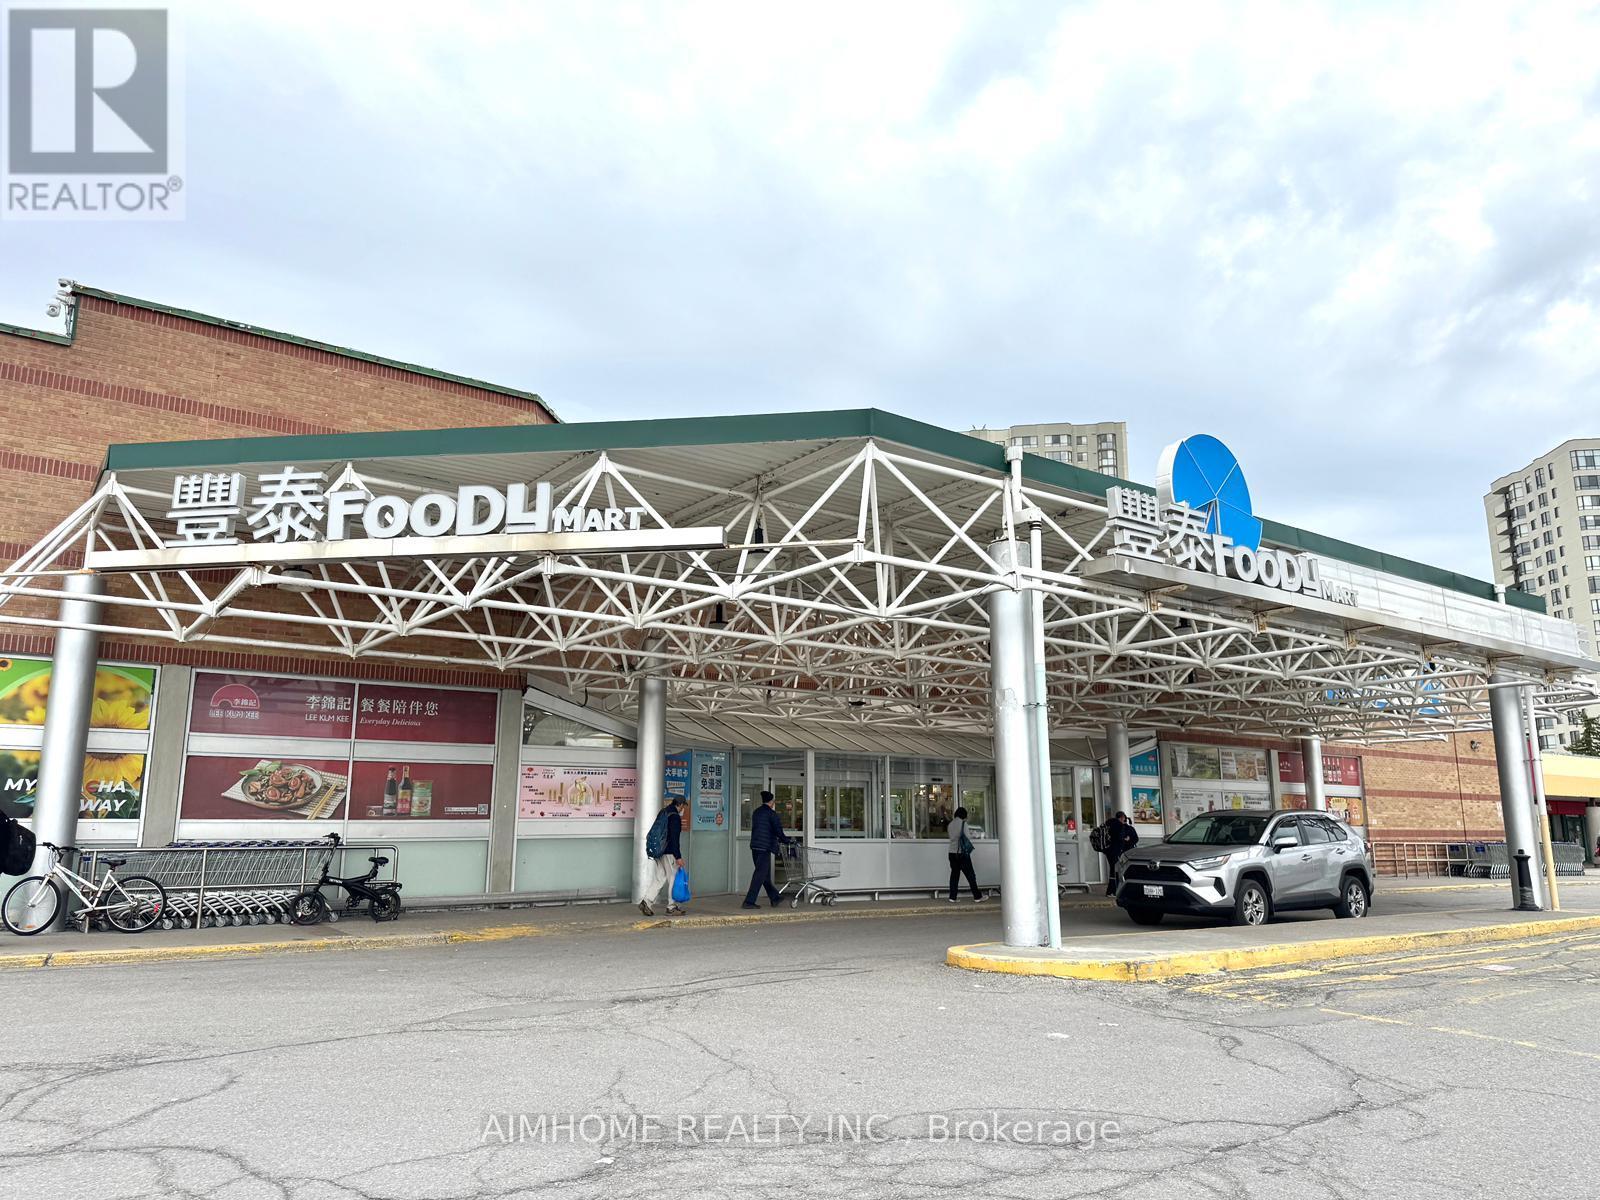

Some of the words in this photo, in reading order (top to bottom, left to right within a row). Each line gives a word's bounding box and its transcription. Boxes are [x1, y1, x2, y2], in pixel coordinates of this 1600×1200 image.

[165, 466, 328, 547] 豐泰
[552, 505, 646, 533] MART
[1106, 486, 1214, 572] 豐泰
[1320, 579, 1360, 607] MART
[305, 695, 352, 711] 李錦記
[361, 698, 439, 716] 餐餐陪伴您
[336, 715, 350, 723] KEE
[359, 717, 390, 727] Everyday
[391, 718, 421, 726] Delicious
[4, 778, 37, 791] MY
[79, 799, 127, 812] WAY
